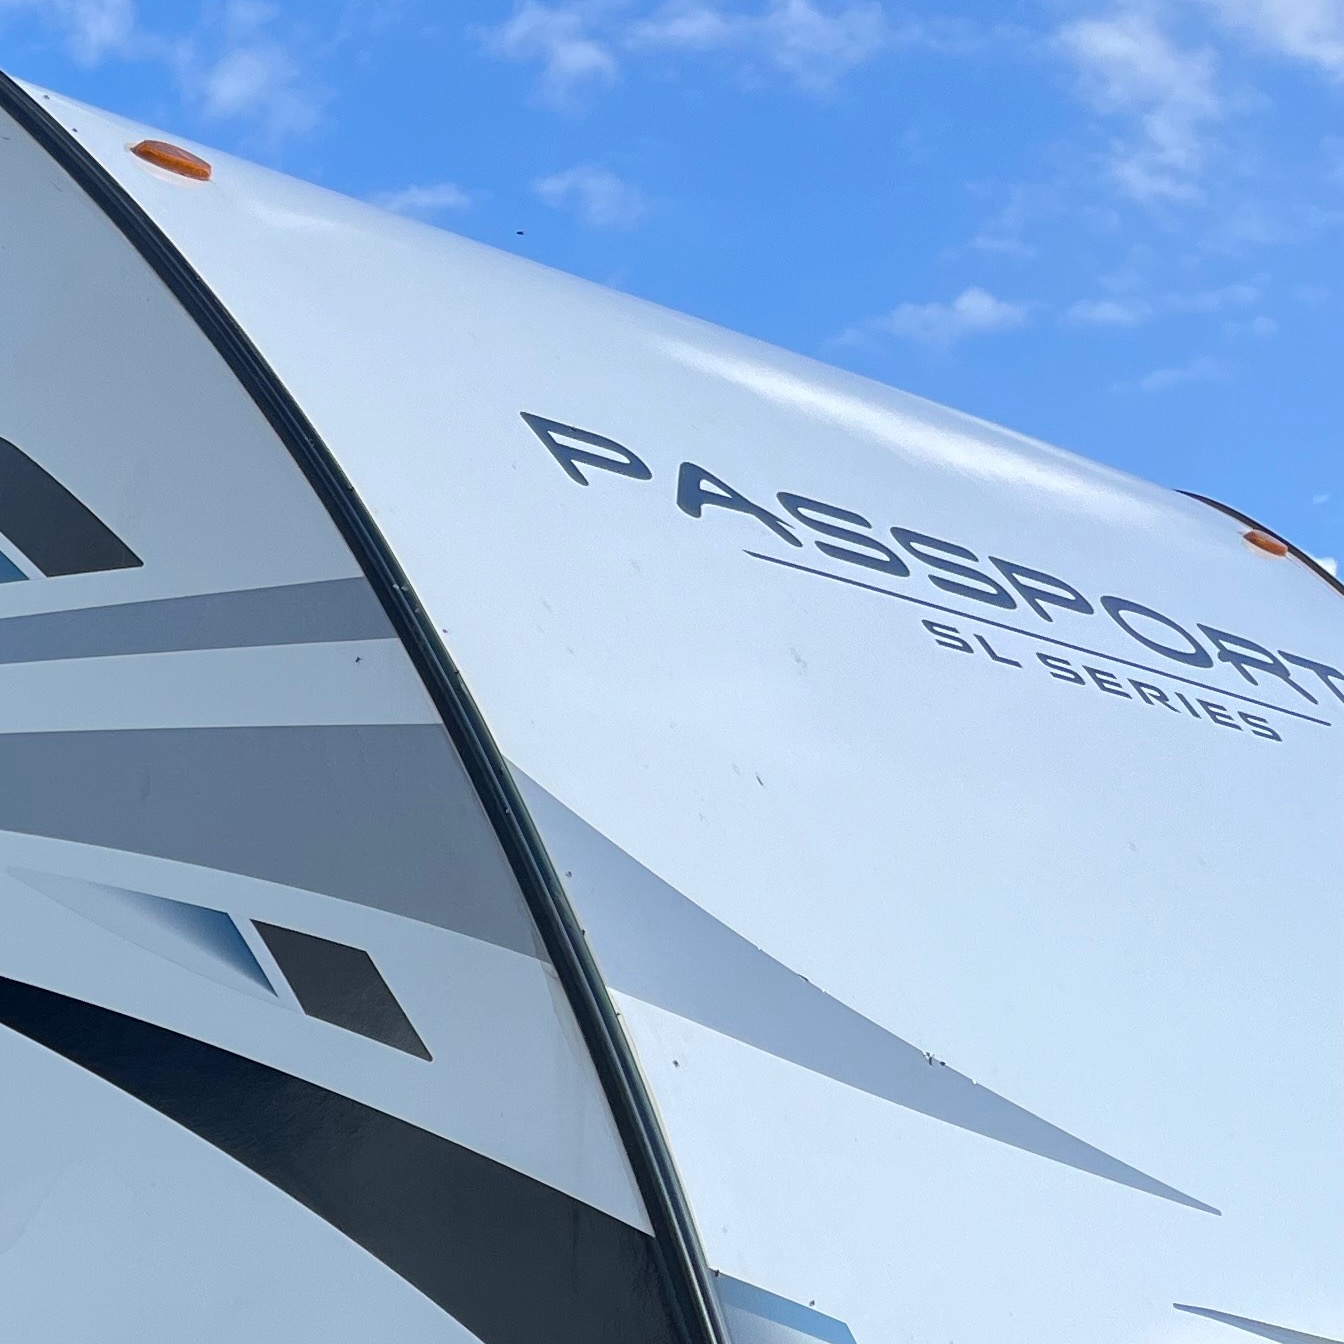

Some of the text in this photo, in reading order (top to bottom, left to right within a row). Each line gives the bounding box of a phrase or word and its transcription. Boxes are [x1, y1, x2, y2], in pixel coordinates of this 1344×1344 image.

[520, 411, 1344, 705] PASSPORT
[921, 620, 1283, 742] SL SERIES
